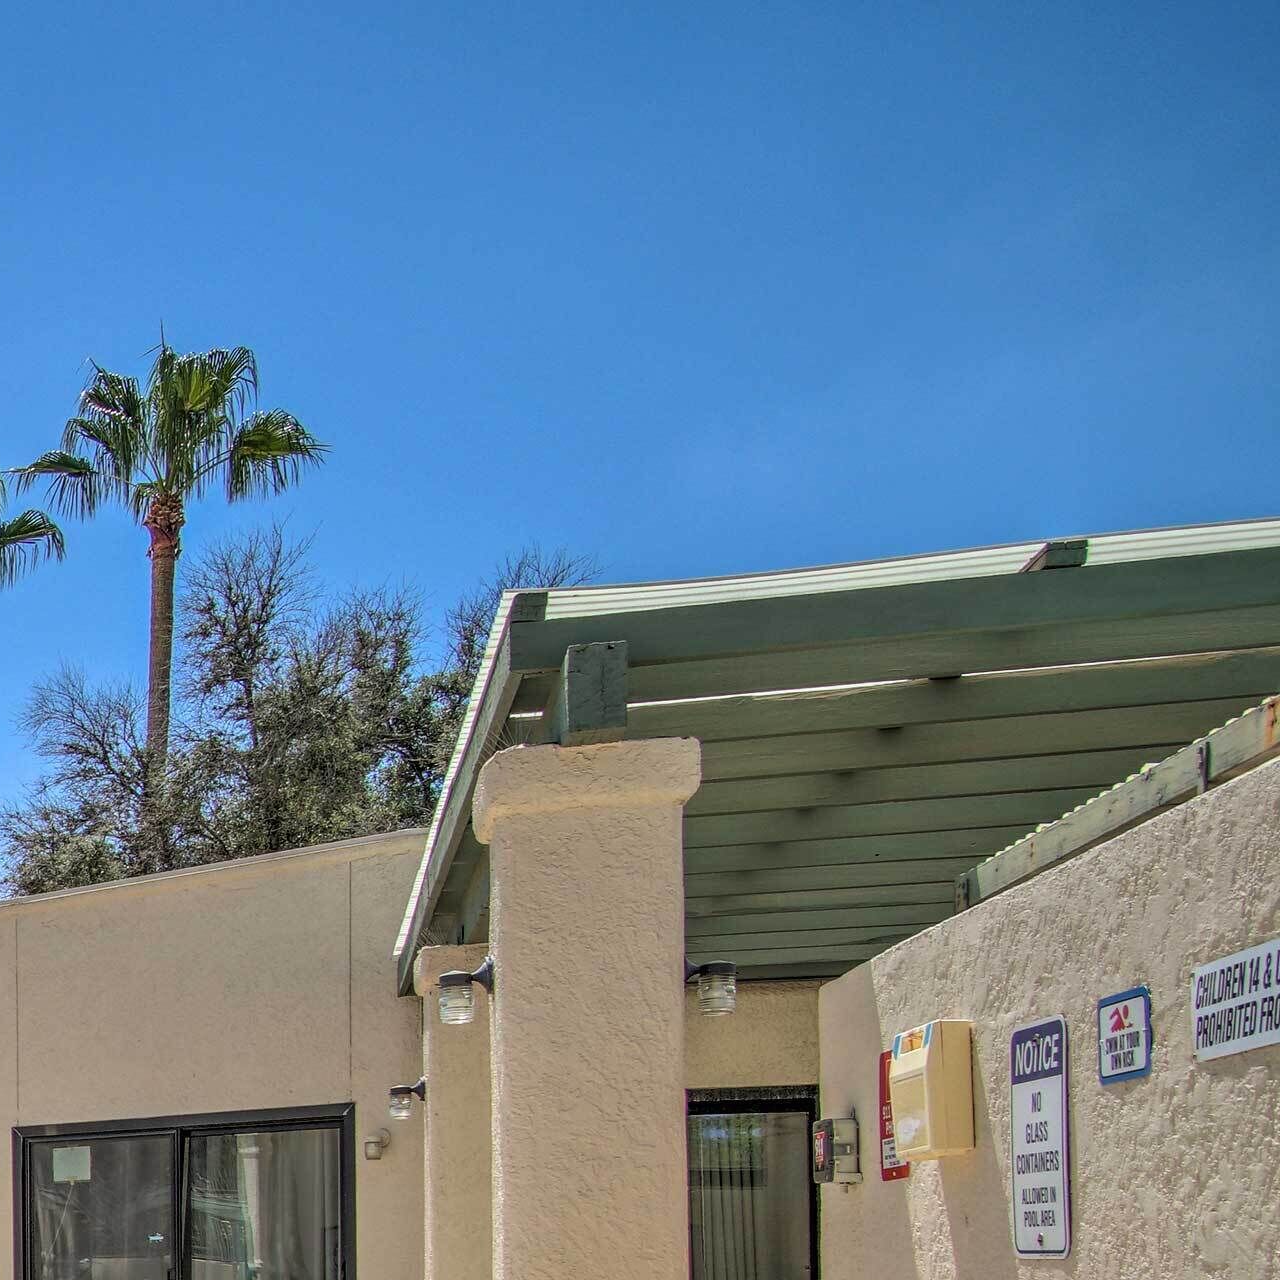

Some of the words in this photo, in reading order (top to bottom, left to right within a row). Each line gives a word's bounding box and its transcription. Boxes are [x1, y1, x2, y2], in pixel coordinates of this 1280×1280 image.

[1195, 961, 1247, 1010] CHILDREN
[1248, 956, 1260, 994] 14
[1263, 952, 1272, 990] &
[1196, 1001, 1258, 1050] PROHIBITED
[1015, 1033, 1060, 1077] NOTICE
[1031, 1091, 1042, 1113] NO
[1025, 1121, 1048, 1145] GLASS
[1016, 1150, 1060, 1175] CONTAINERS
[1021, 1187, 1049, 1205] ALLOWED
[1049, 1186, 1057, 1203] IN
[1023, 1210, 1040, 1228] POOL
[1040, 1210, 1056, 1227] AREA
